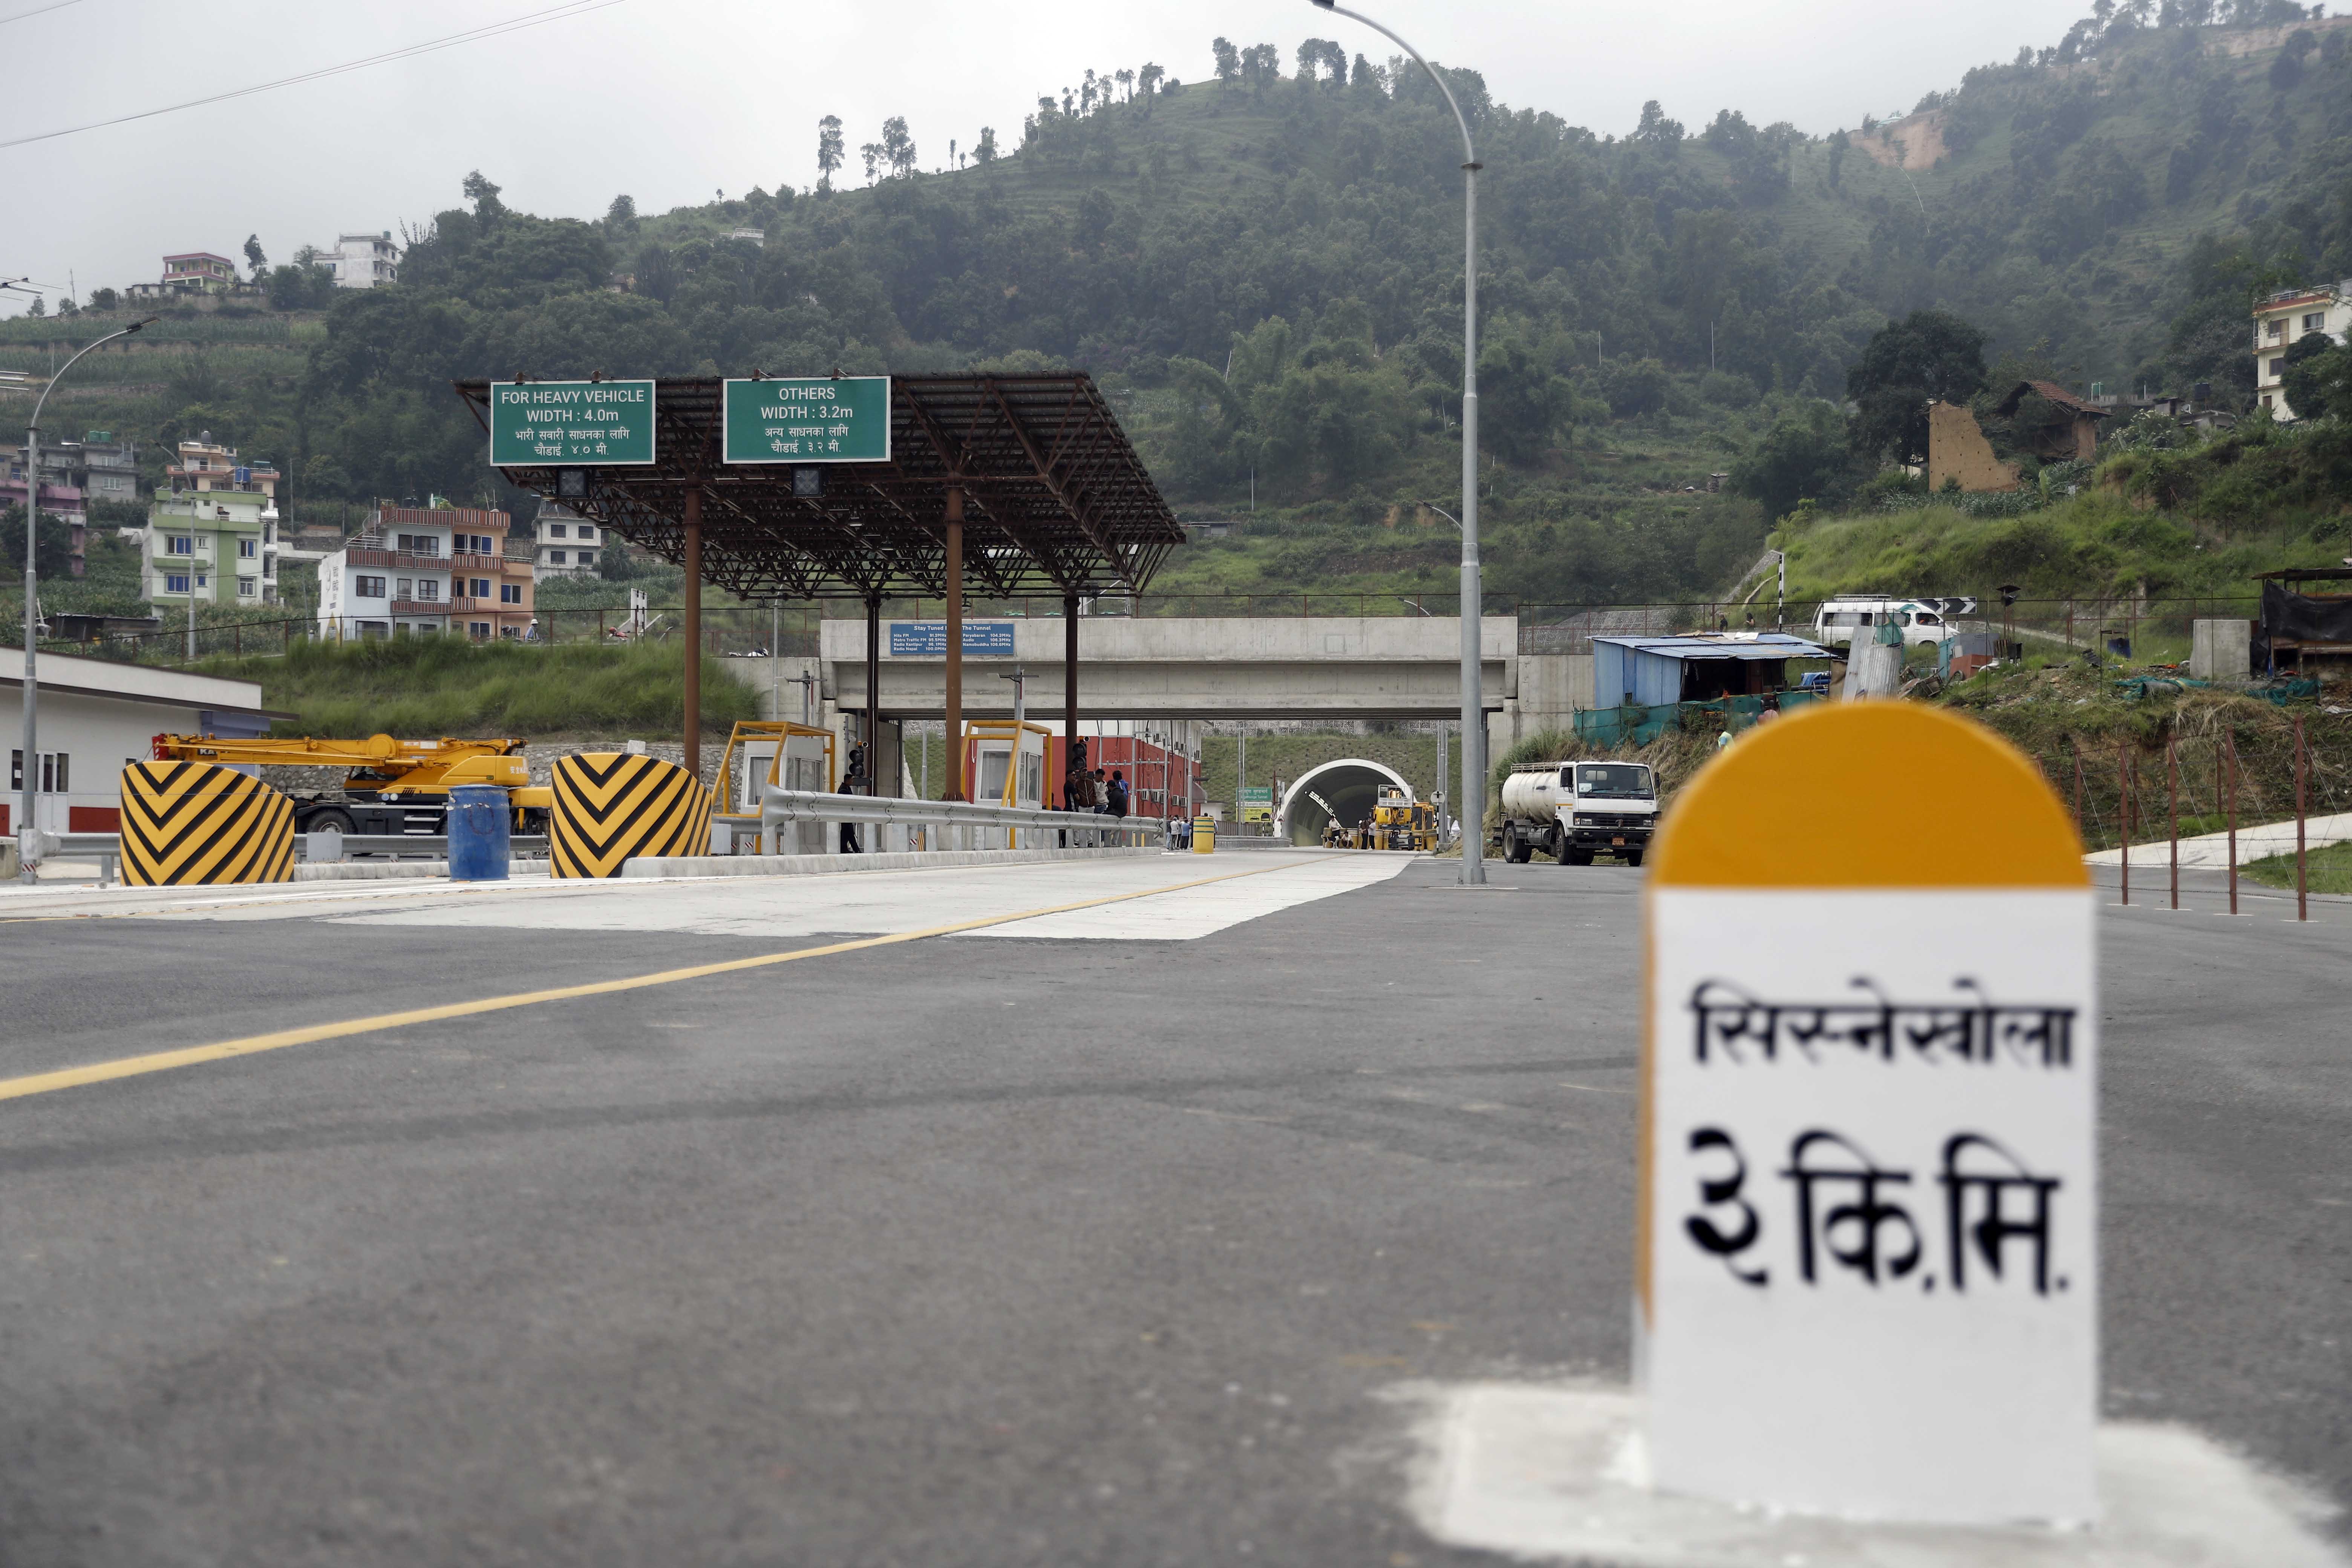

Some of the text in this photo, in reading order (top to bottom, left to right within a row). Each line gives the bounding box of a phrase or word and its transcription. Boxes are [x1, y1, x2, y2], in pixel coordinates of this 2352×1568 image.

[502, 390, 644, 404] FOR HEAVY VEHICLE
[779, 387, 835, 400] OTHERS
[527, 410, 572, 422] WIDTH
[585, 409, 618, 421] 4.0m
[761, 407, 807, 419] WIDTH
[819, 406, 853, 418] 3.2m
[516, 427, 629, 441] भारी सवारी साधनका लागि
[765, 424, 848, 438] अन्य साधनका लागि
[571, 445, 590, 455] ४.०
[596, 443, 609, 455] मी.
[808, 442, 823, 453] ३.२
[828, 440, 841, 452] मी.
[1683, 1127, 1768, 1286] ३
